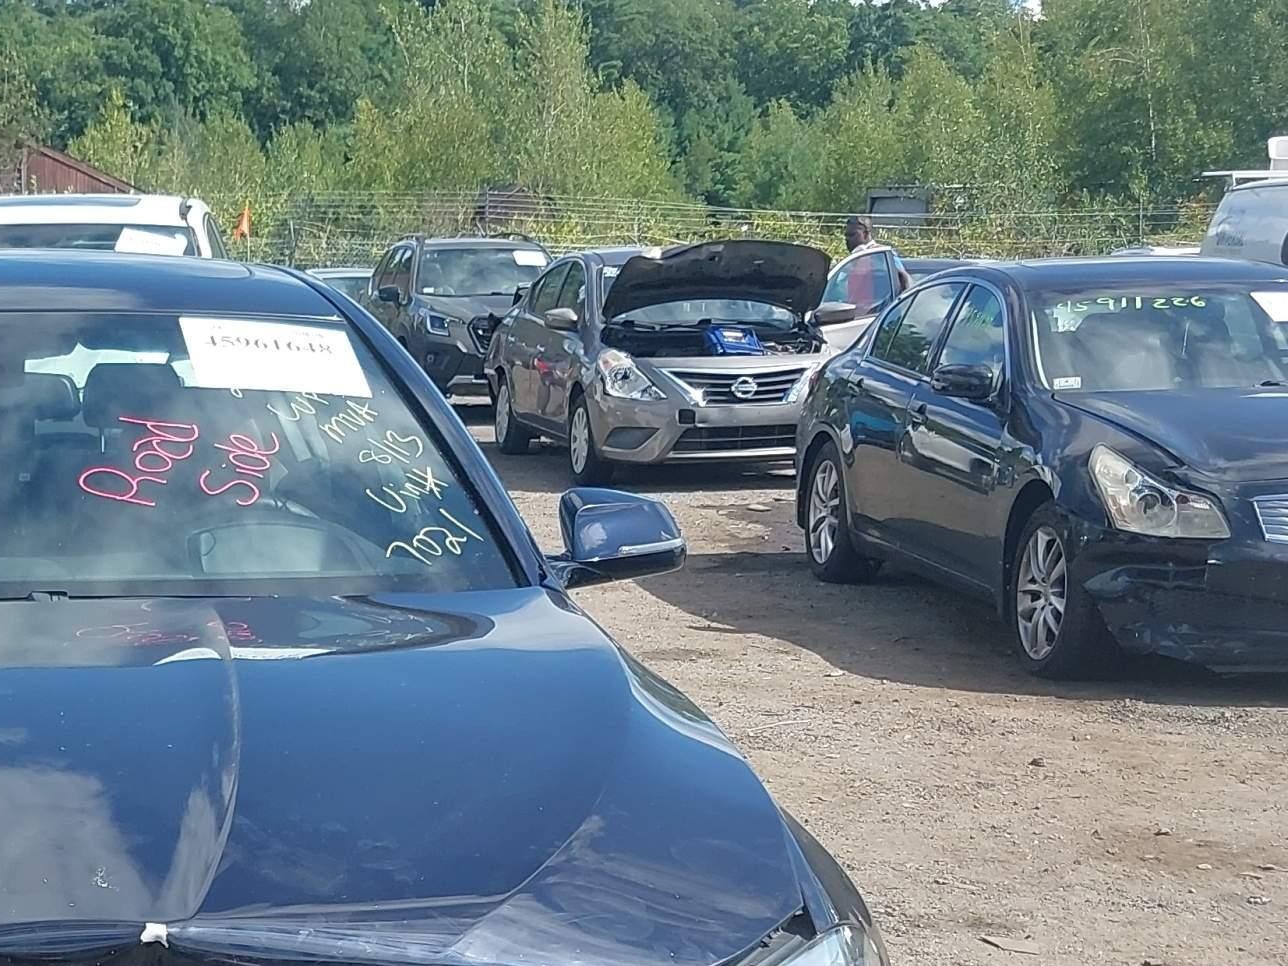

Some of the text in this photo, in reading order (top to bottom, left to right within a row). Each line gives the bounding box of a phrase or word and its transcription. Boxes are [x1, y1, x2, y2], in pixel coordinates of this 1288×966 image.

[198, 432, 280, 505] Side
[358, 429, 423, 465] 8/13
[385, 508, 485, 566] 7021
